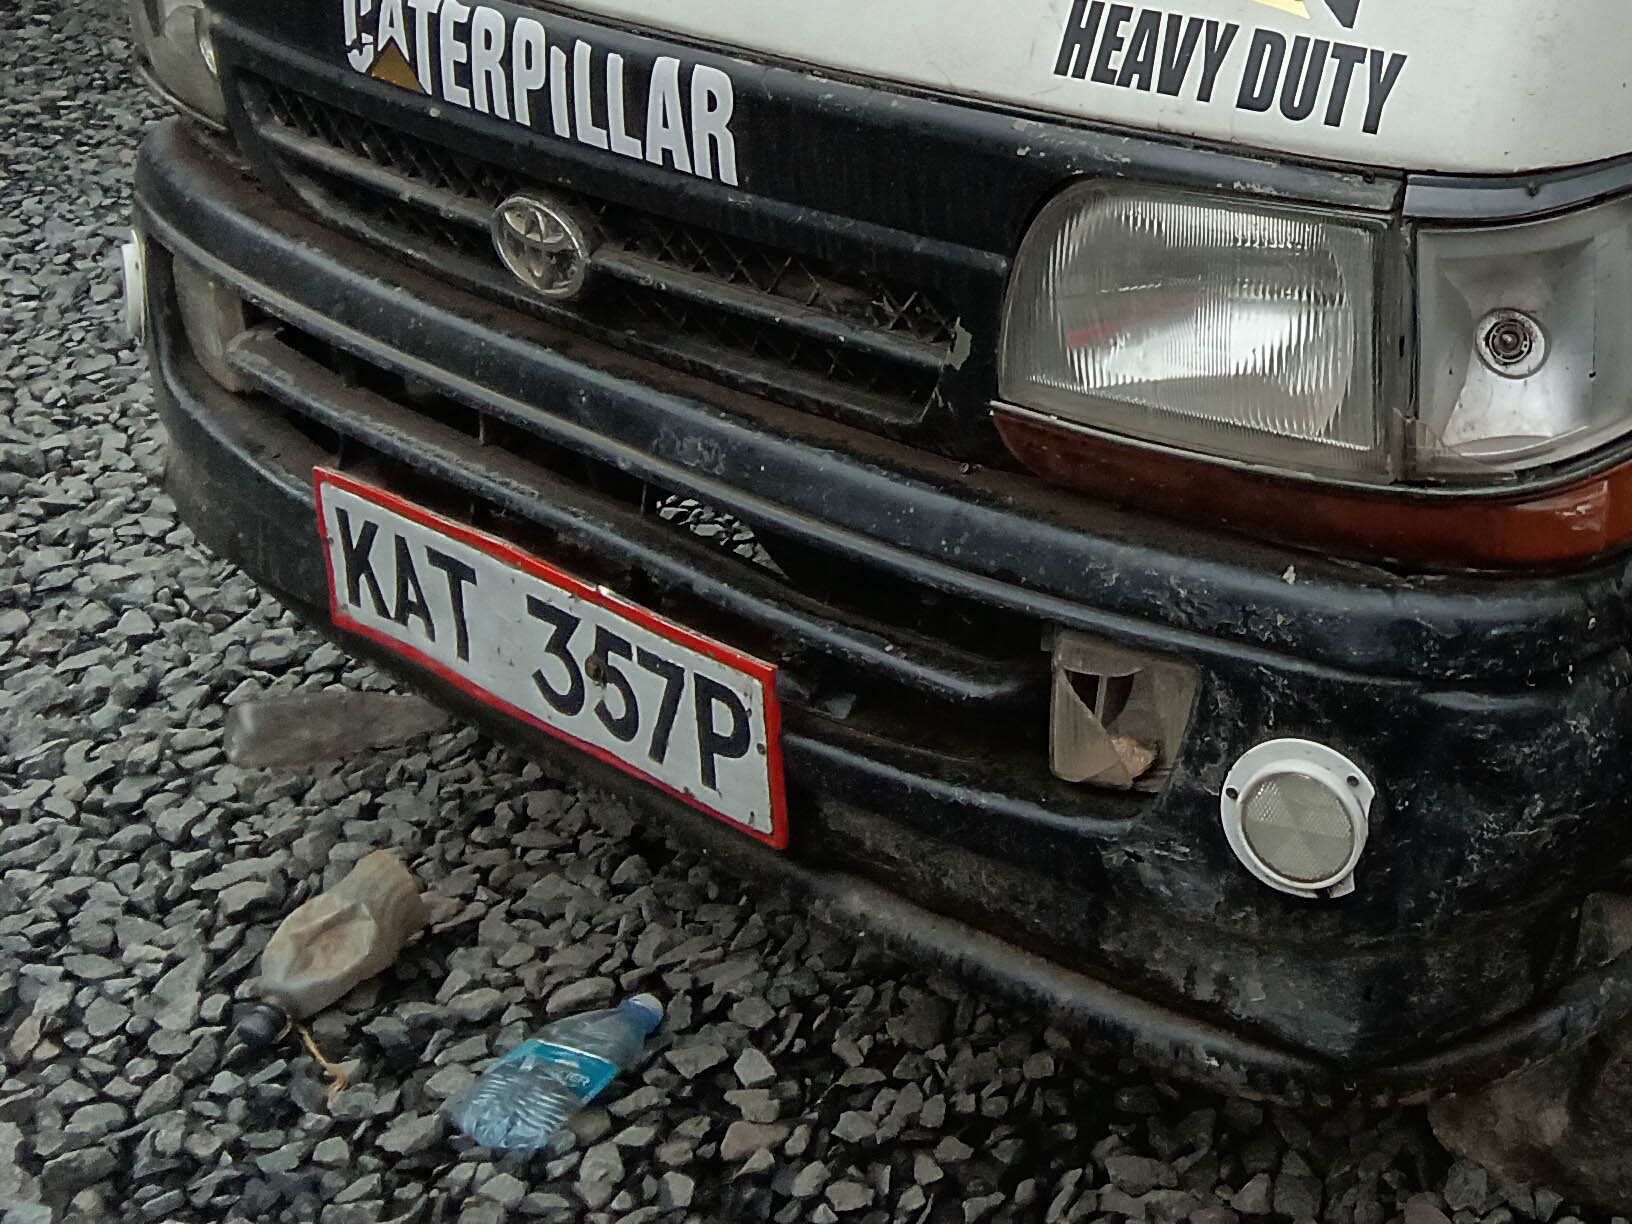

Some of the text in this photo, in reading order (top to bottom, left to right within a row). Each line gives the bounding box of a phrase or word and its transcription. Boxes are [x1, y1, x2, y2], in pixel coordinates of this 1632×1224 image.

[1236, 28, 1407, 135] DUTY
[335, 507, 752, 792] KAT 357P
